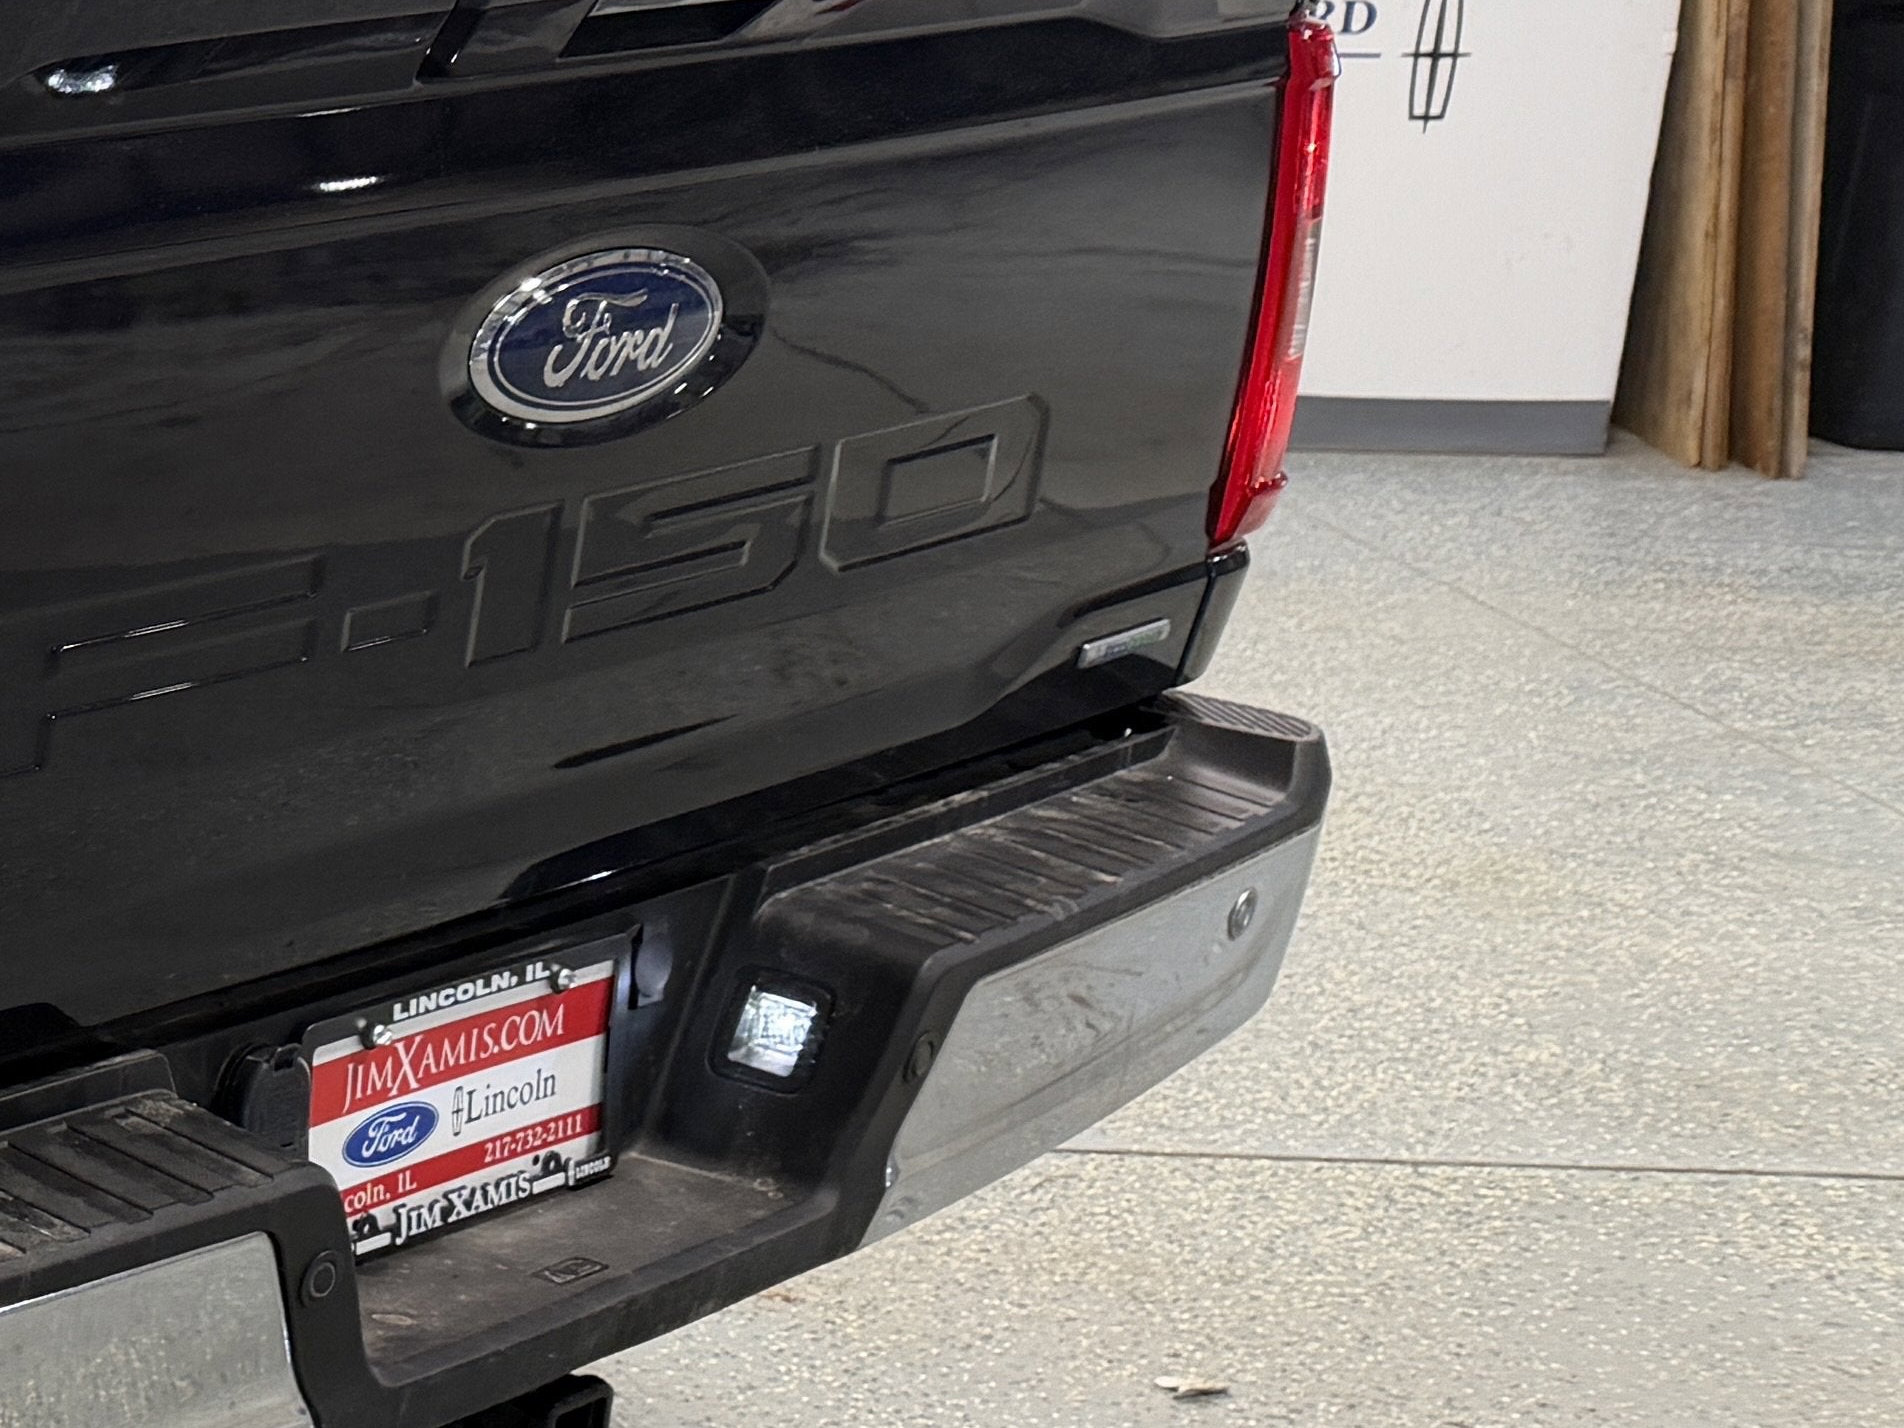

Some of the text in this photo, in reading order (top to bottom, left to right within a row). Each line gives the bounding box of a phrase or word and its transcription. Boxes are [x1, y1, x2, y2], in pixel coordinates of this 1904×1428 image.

[543, 287, 680, 388] Ford
[393, 960, 552, 1022] LINCOLN, IL
[343, 1003, 565, 1114] JIMXAMIS.COM
[361, 1068, 557, 1158] Ford Lincoln
[344, 1114, 583, 1213] coln, IL 217-732-2111
[395, 1172, 533, 1245] JIM XAMIS
